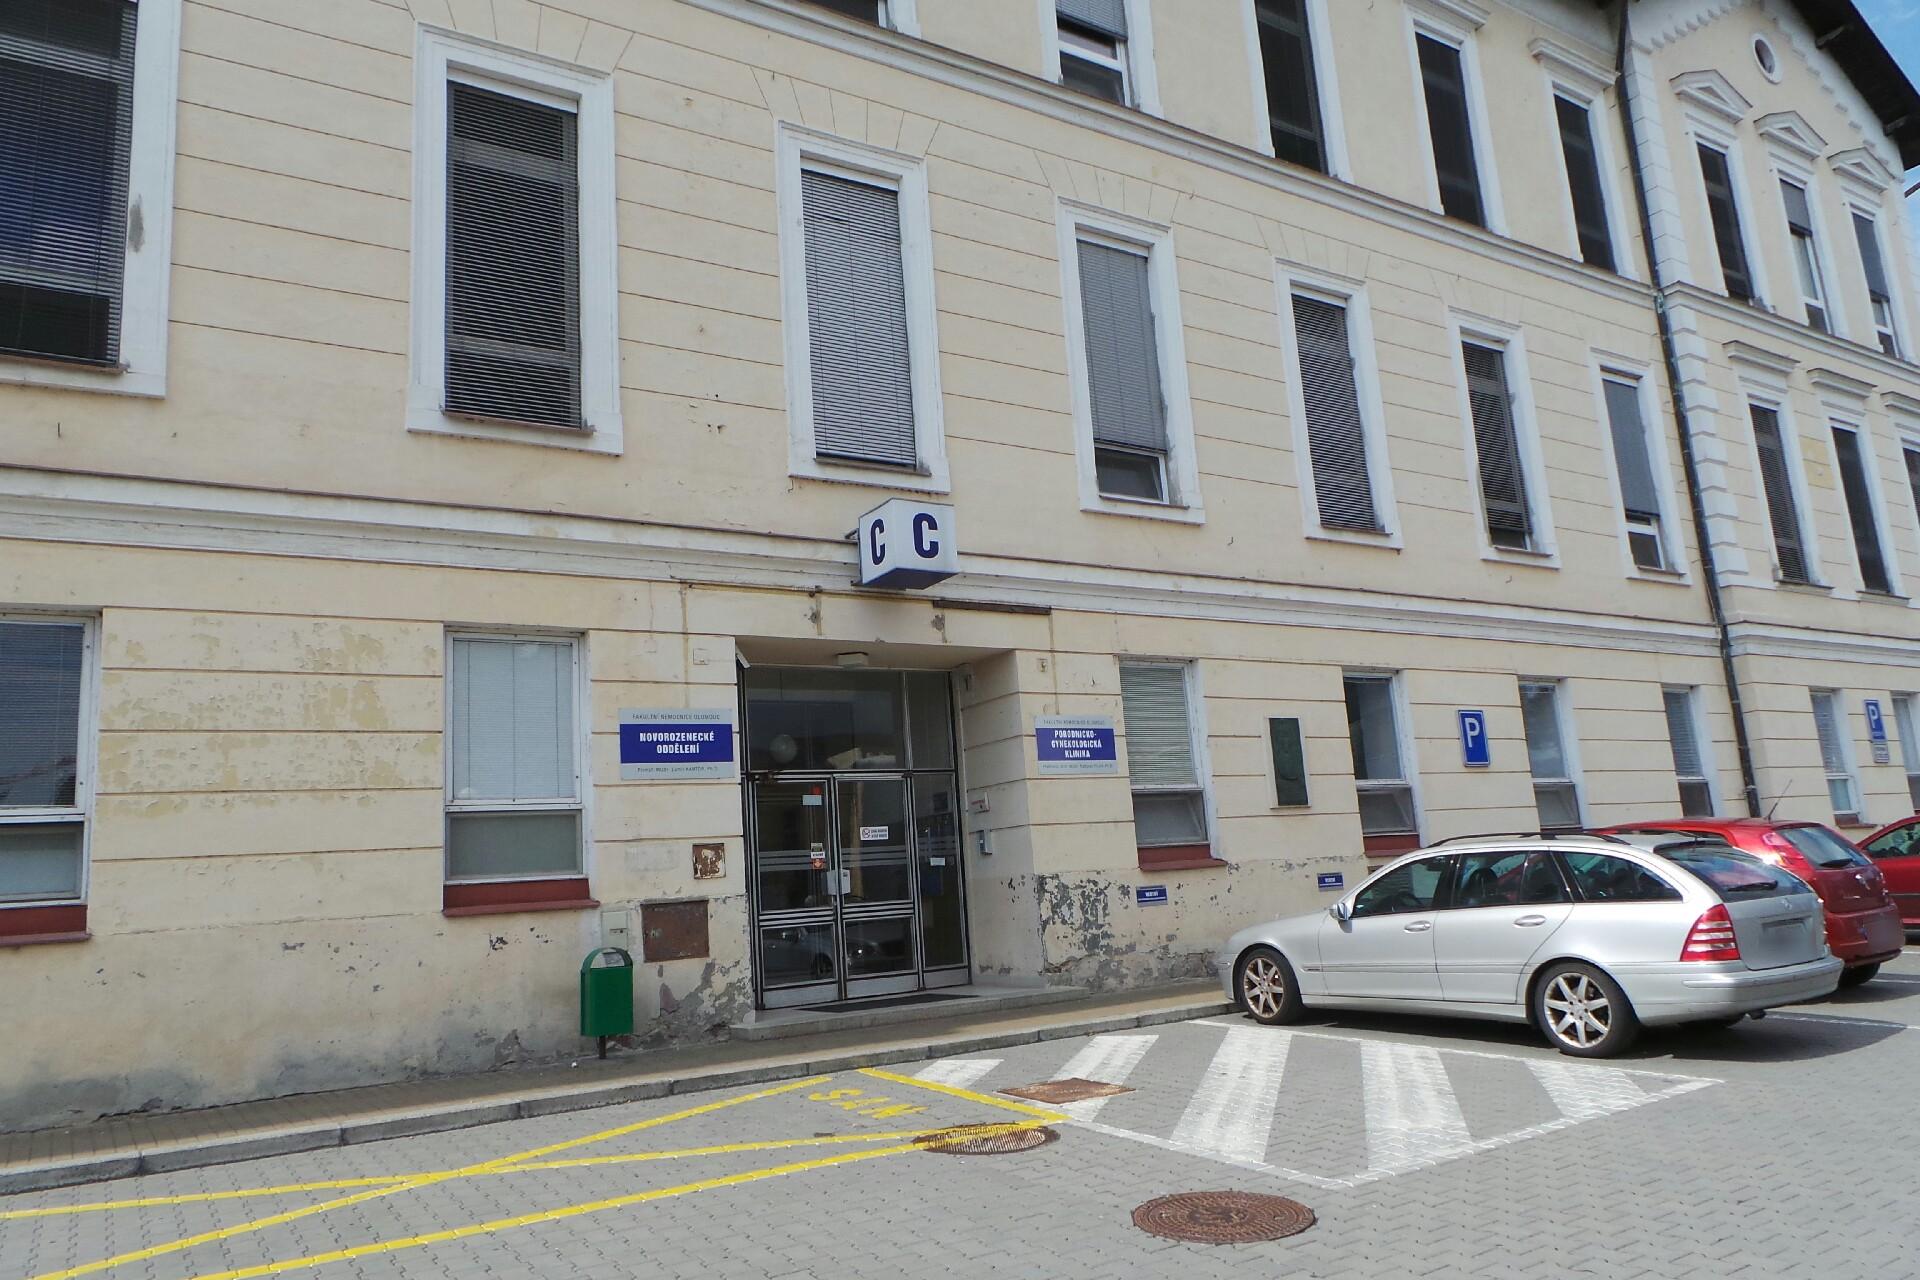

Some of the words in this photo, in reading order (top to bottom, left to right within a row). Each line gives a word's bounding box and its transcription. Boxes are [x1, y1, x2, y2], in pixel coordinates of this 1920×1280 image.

[913, 513, 939, 558] C
[871, 519, 885, 565] C
[1868, 705, 1878, 728] P
[640, 731, 714, 742] NOVOROZENECKÉ
[1055, 730, 1096, 738] PORODNICKO-
[1464, 717, 1480, 748] P
[657, 742, 700, 753] ODDĚLENÍ
[1051, 739, 1102, 748] GYNEKOLOGICKÁ
[1065, 750, 1090, 758] KLINIKA
